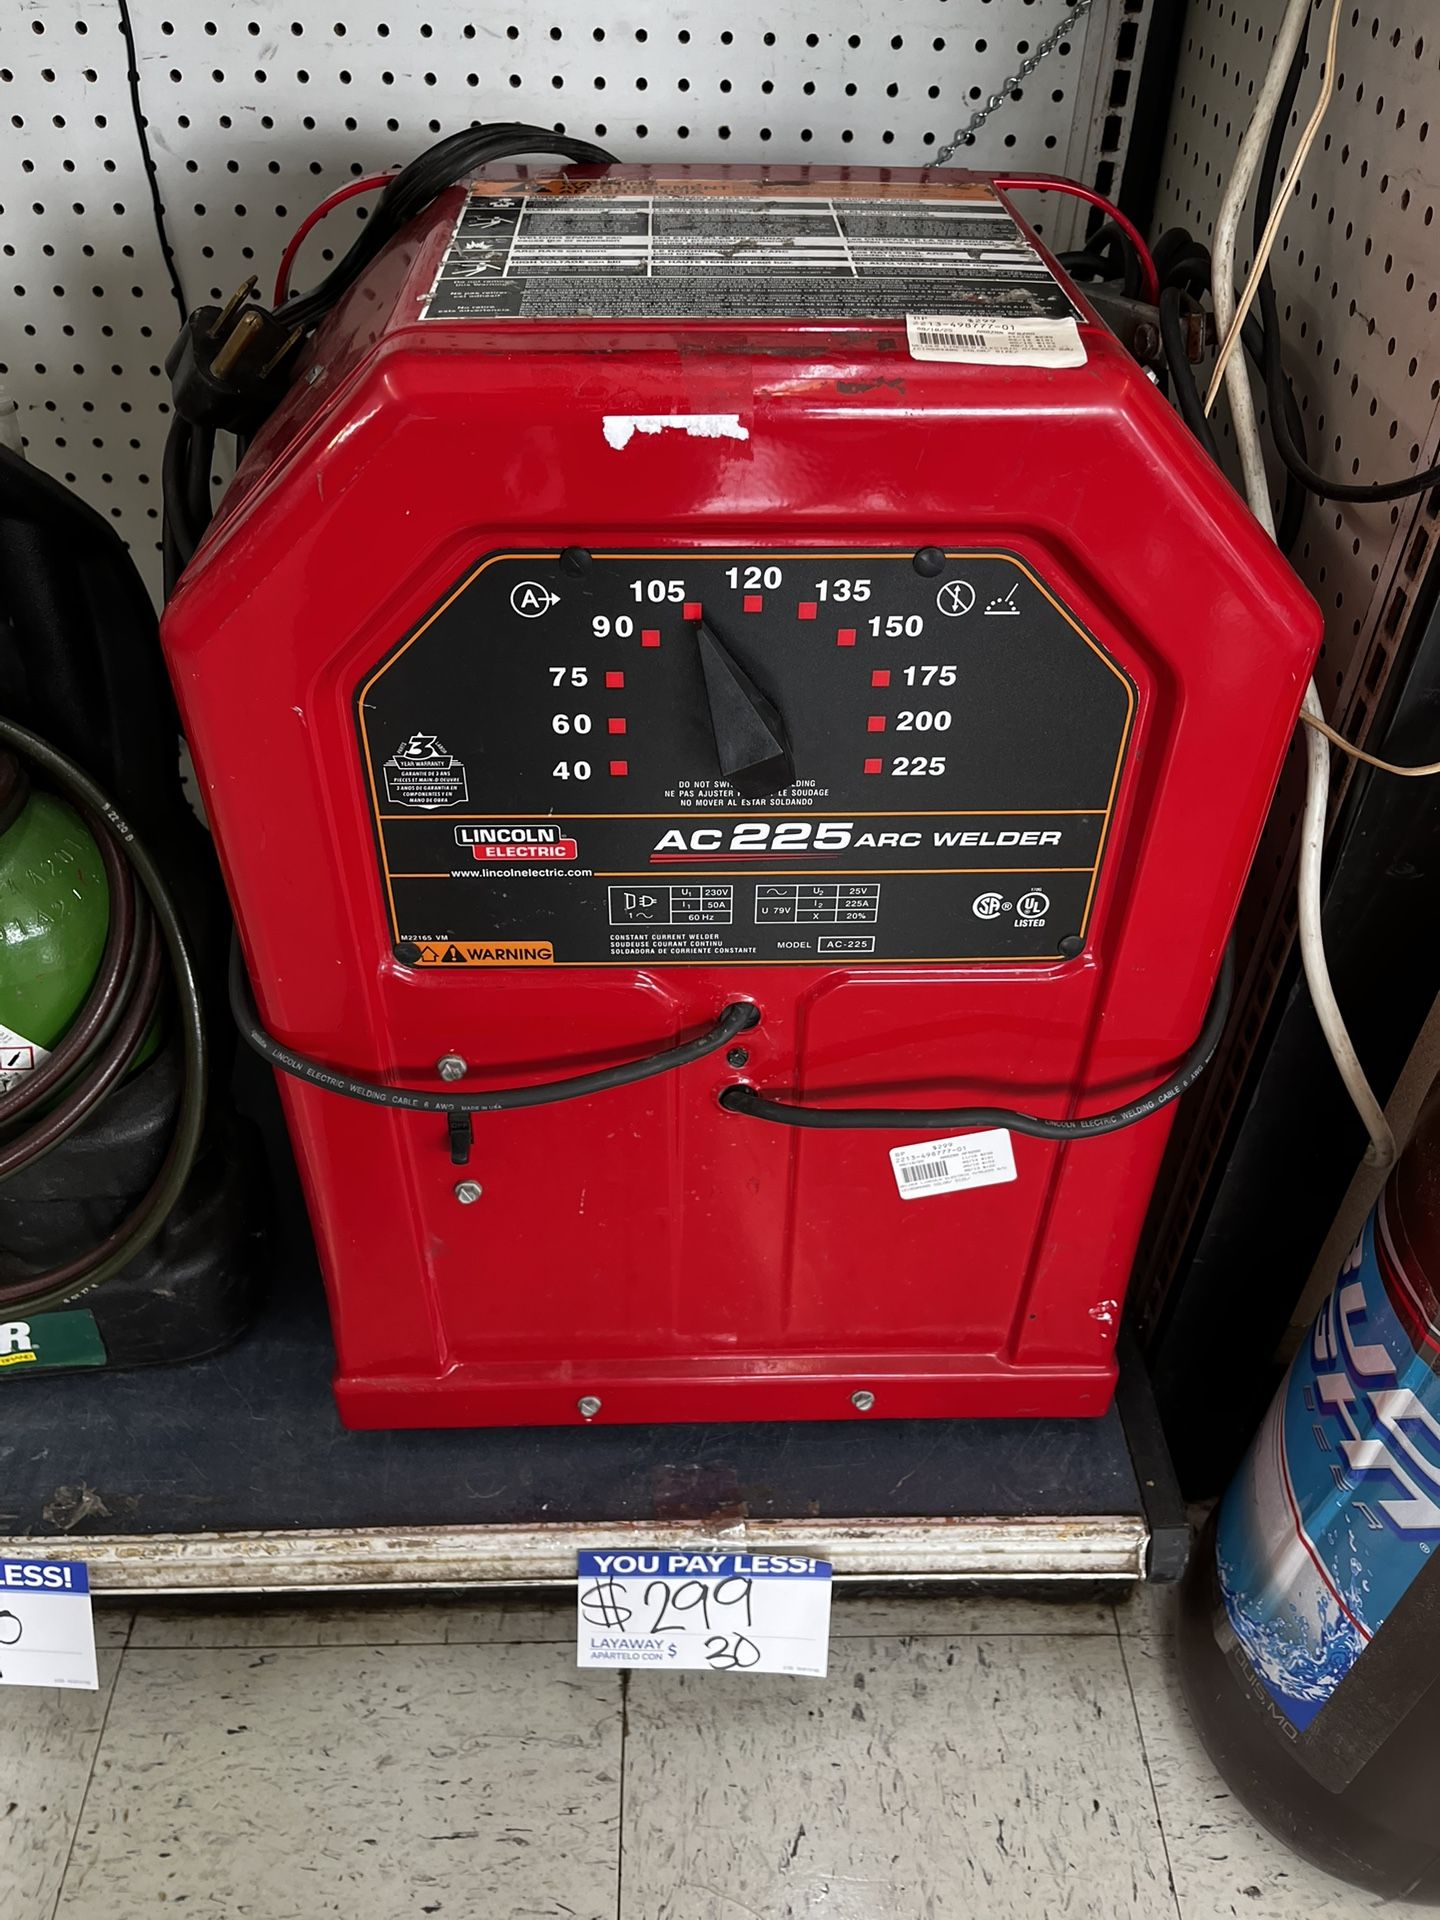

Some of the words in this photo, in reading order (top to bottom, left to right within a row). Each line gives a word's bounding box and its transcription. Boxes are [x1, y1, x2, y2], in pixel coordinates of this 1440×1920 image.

[725, 567, 783, 590] 120
[629, 580, 686, 602] 105
[815, 579, 872, 602] 135
[591, 615, 634, 638] 90
[868, 615, 923, 637] 150
[548, 667, 588, 687] 75
[903, 665, 957, 686] 175
[552, 714, 592, 734] 60
[896, 710, 952, 732] 200
[552, 760, 592, 780] 40
[891, 756, 946, 776] 225
[770, 798, 814, 806] SOLDANDO
[791, 788, 829, 796] SOUDAGE
[461, 828, 555, 843] LINCOLN
[854, 832, 922, 848] ARC
[933, 830, 1062, 848] WELDER
[485, 846, 566, 858] ELECTRIC
[451, 868, 593, 878] www.lincolnelectric.com
[1014, 919, 1046, 928] LISTED
[466, 947, 553, 961] WARNING
[777, 941, 812, 949] MODEL
[272, 1048, 302, 1071] LINCOLN
[306, 1068, 345, 1089] ELECTRIC
[350, 1084, 387, 1102] WELDING
[392, 1095, 419, 1108] CABLE
[1080, 1116, 1118, 1128] ELECTRIC
[1121, 1100, 1156, 1120] WELDING
[1158, 1086, 1181, 1104] CABLE
[932, 1142, 954, 1150] $299
[1302, 1385, 1384, 1530] BEER
[593, 1556, 660, 1574] YOU
[668, 1555, 729, 1573] PAY
[734, 1554, 816, 1574] LESS!
[590, 1638, 664, 1650] LAYAWAY
[668, 1644, 677, 1658] $
[642, 1651, 664, 1660] CON
[704, 1632, 760, 1670] 30
[1266, 1702, 1298, 1744] MO.
